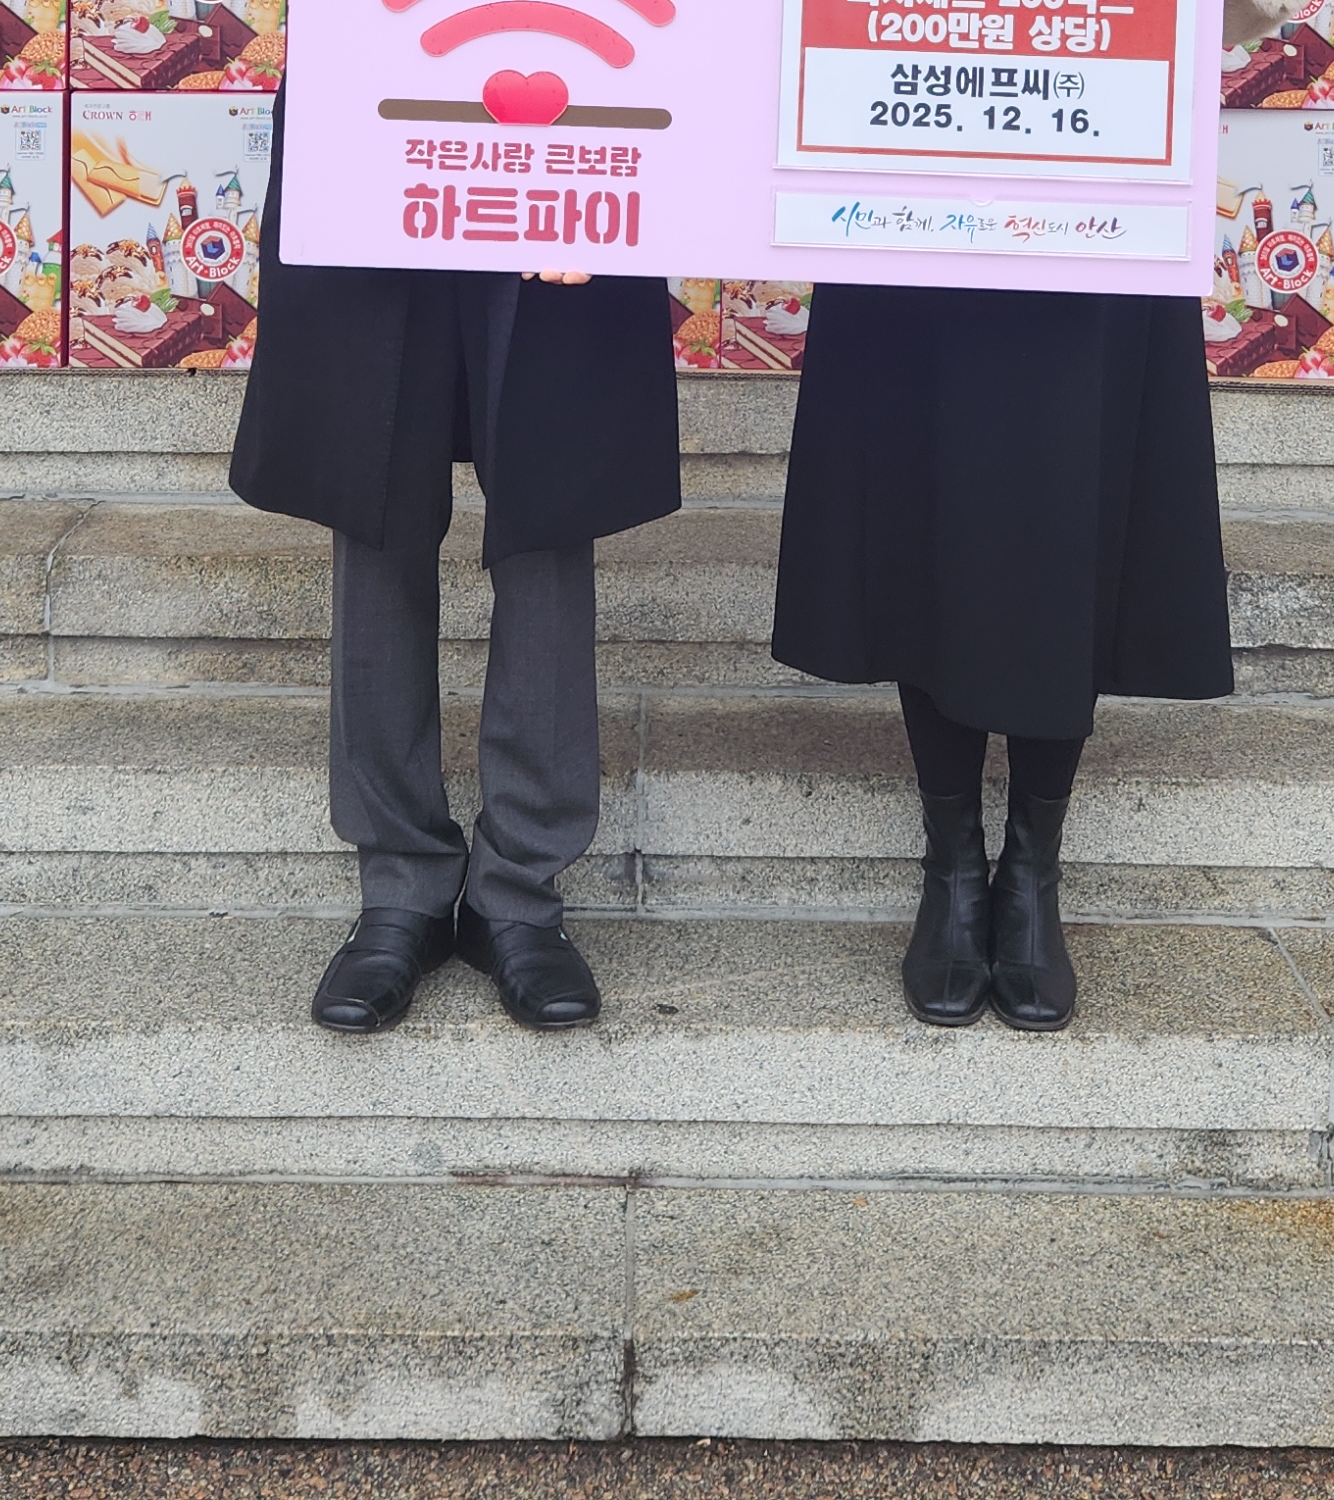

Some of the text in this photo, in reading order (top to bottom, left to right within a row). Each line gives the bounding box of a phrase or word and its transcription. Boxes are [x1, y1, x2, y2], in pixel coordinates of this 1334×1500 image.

[867, 10, 1112, 53] (200만원 상당)
[11, 104, 53, 113] Art Block
[82, 109, 122, 119] CROWN
[239, 106, 273, 115] Art Blo
[869, 100, 1100, 137] 2025. 12. 16.
[1314, 121, 1329, 130] Art
[405, 138, 642, 177] 작은사랑 큰보람
[402, 182, 641, 247] 하트파이
[831, 201, 892, 237] 시민과
[939, 213, 999, 244] 자유로운
[1004, 214, 1069, 244] 혁신도시
[1075, 215, 1128, 240] 안산
